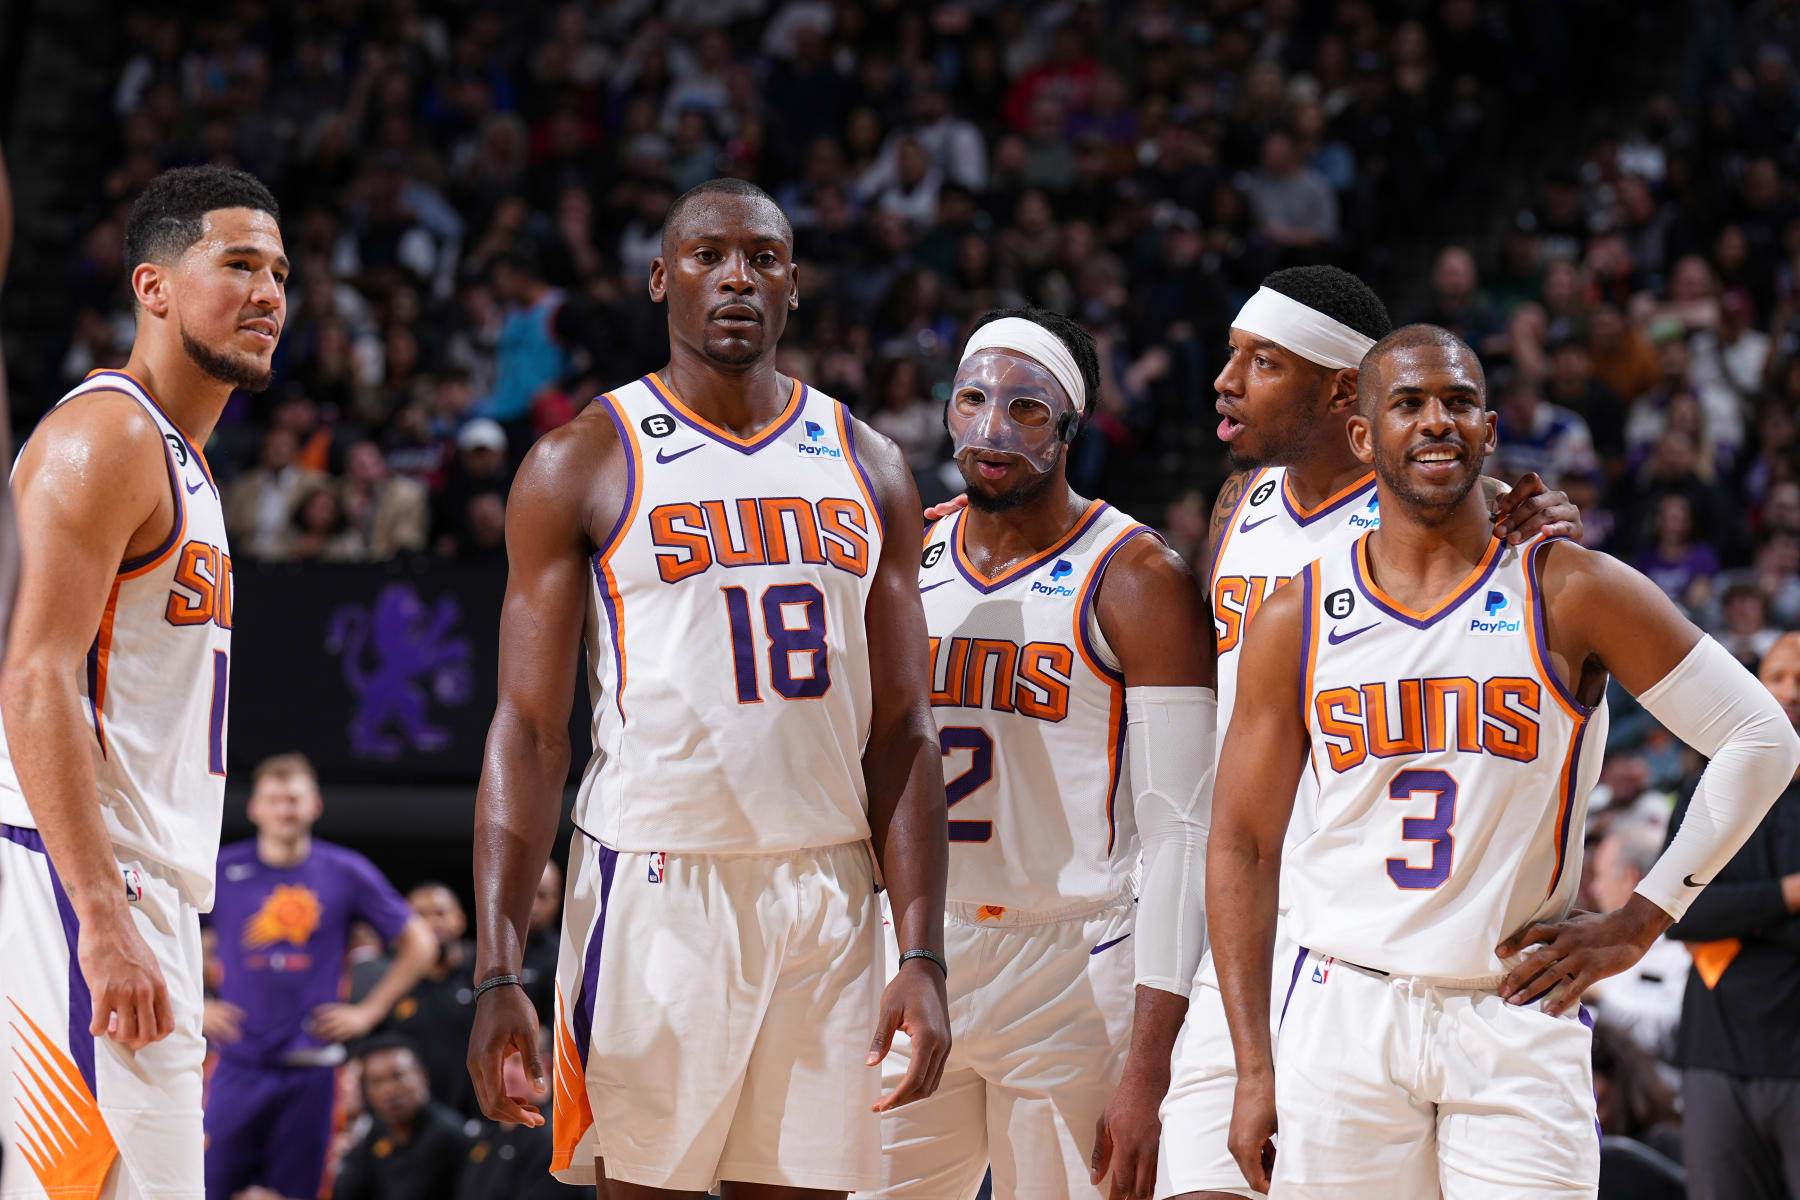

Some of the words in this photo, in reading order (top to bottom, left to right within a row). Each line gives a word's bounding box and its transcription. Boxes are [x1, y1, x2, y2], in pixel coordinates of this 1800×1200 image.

[647, 417, 670, 436] 6
[798, 443, 840, 458] PayPal
[1253, 483, 1274, 504] 6
[648, 497, 869, 584] SUNS
[924, 544, 944, 566] 6
[1031, 581, 1075, 597] PayPal
[1331, 591, 1351, 616] 6
[1470, 620, 1520, 633] PayPal
[720, 582, 832, 704] 18
[1314, 676, 1542, 774] SUNS
[938, 726, 994, 843] 2
[1386, 769, 1458, 891] 3
